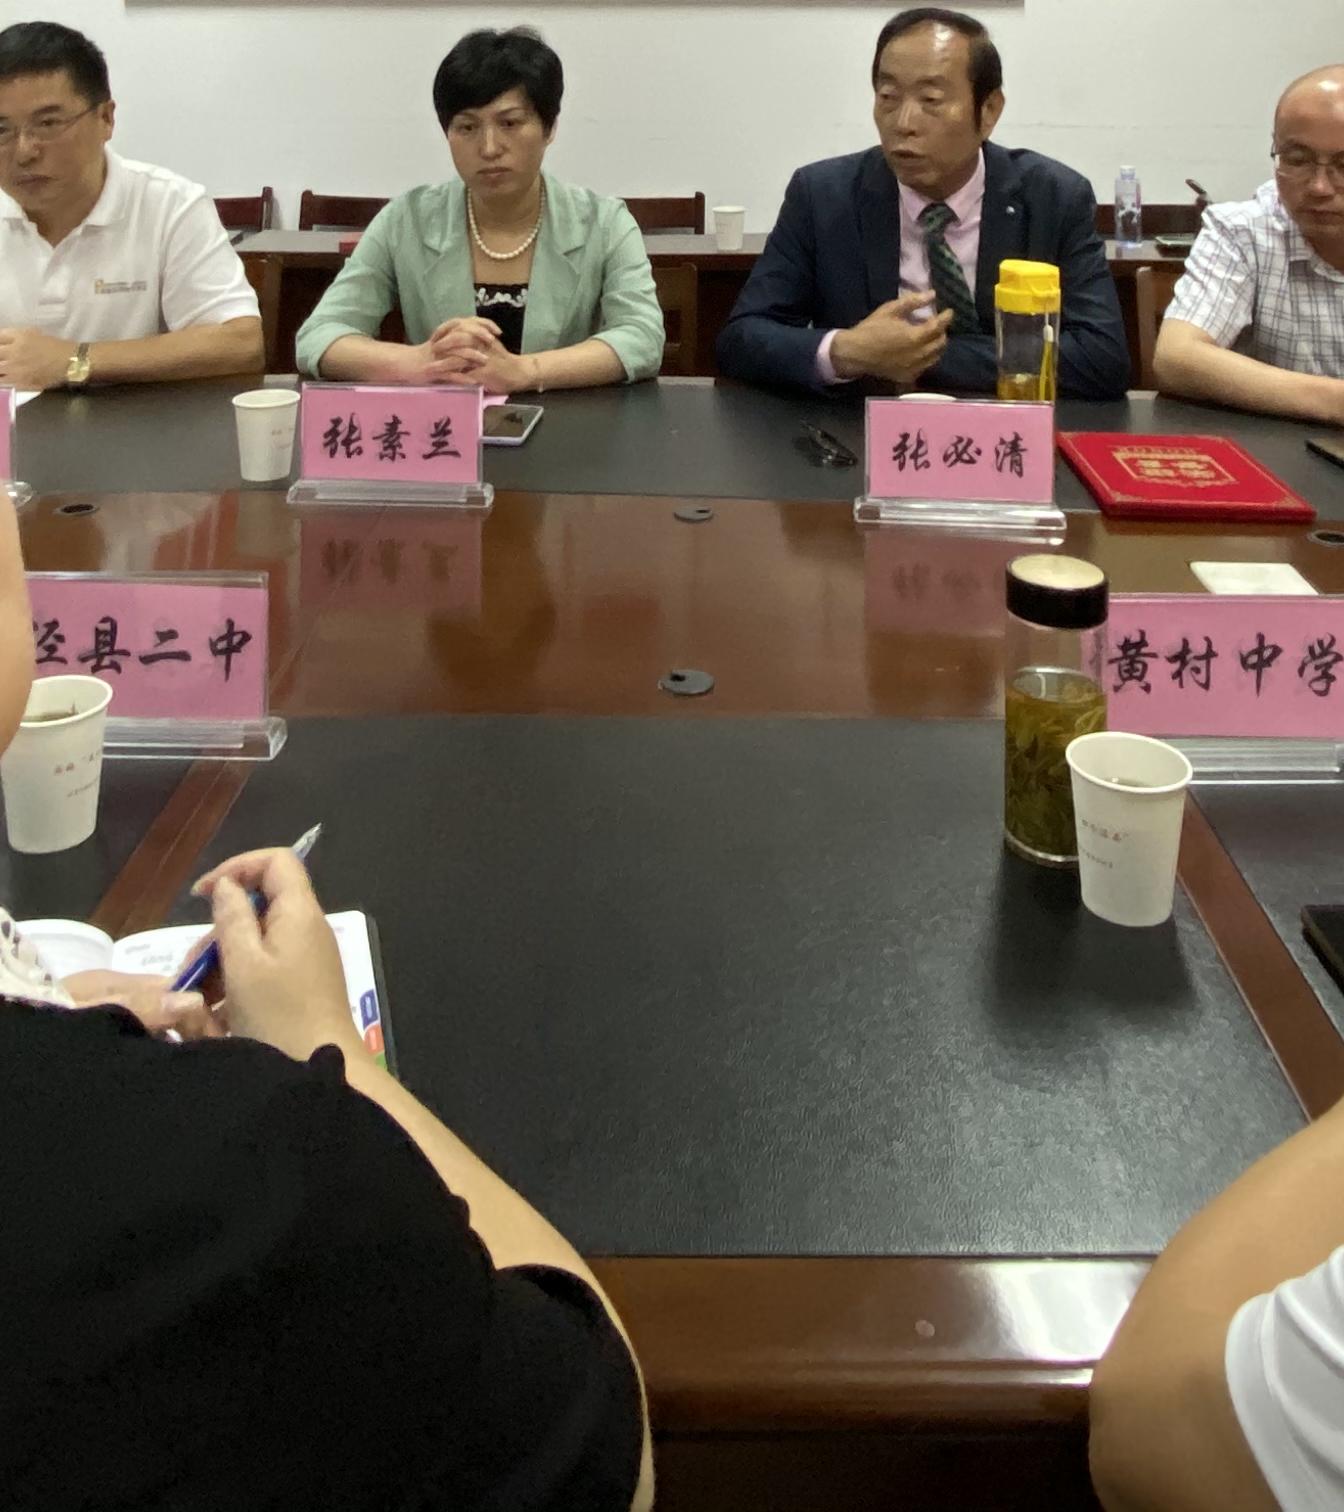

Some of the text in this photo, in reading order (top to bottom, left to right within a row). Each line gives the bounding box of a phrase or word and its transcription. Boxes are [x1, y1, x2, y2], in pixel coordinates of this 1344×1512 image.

[322, 412, 462, 462] 张素兰
[891, 428, 1029, 478] 张必清
[32, 615, 253, 683] 泾县二中
[1108, 629, 1344, 697] 黄村中学
